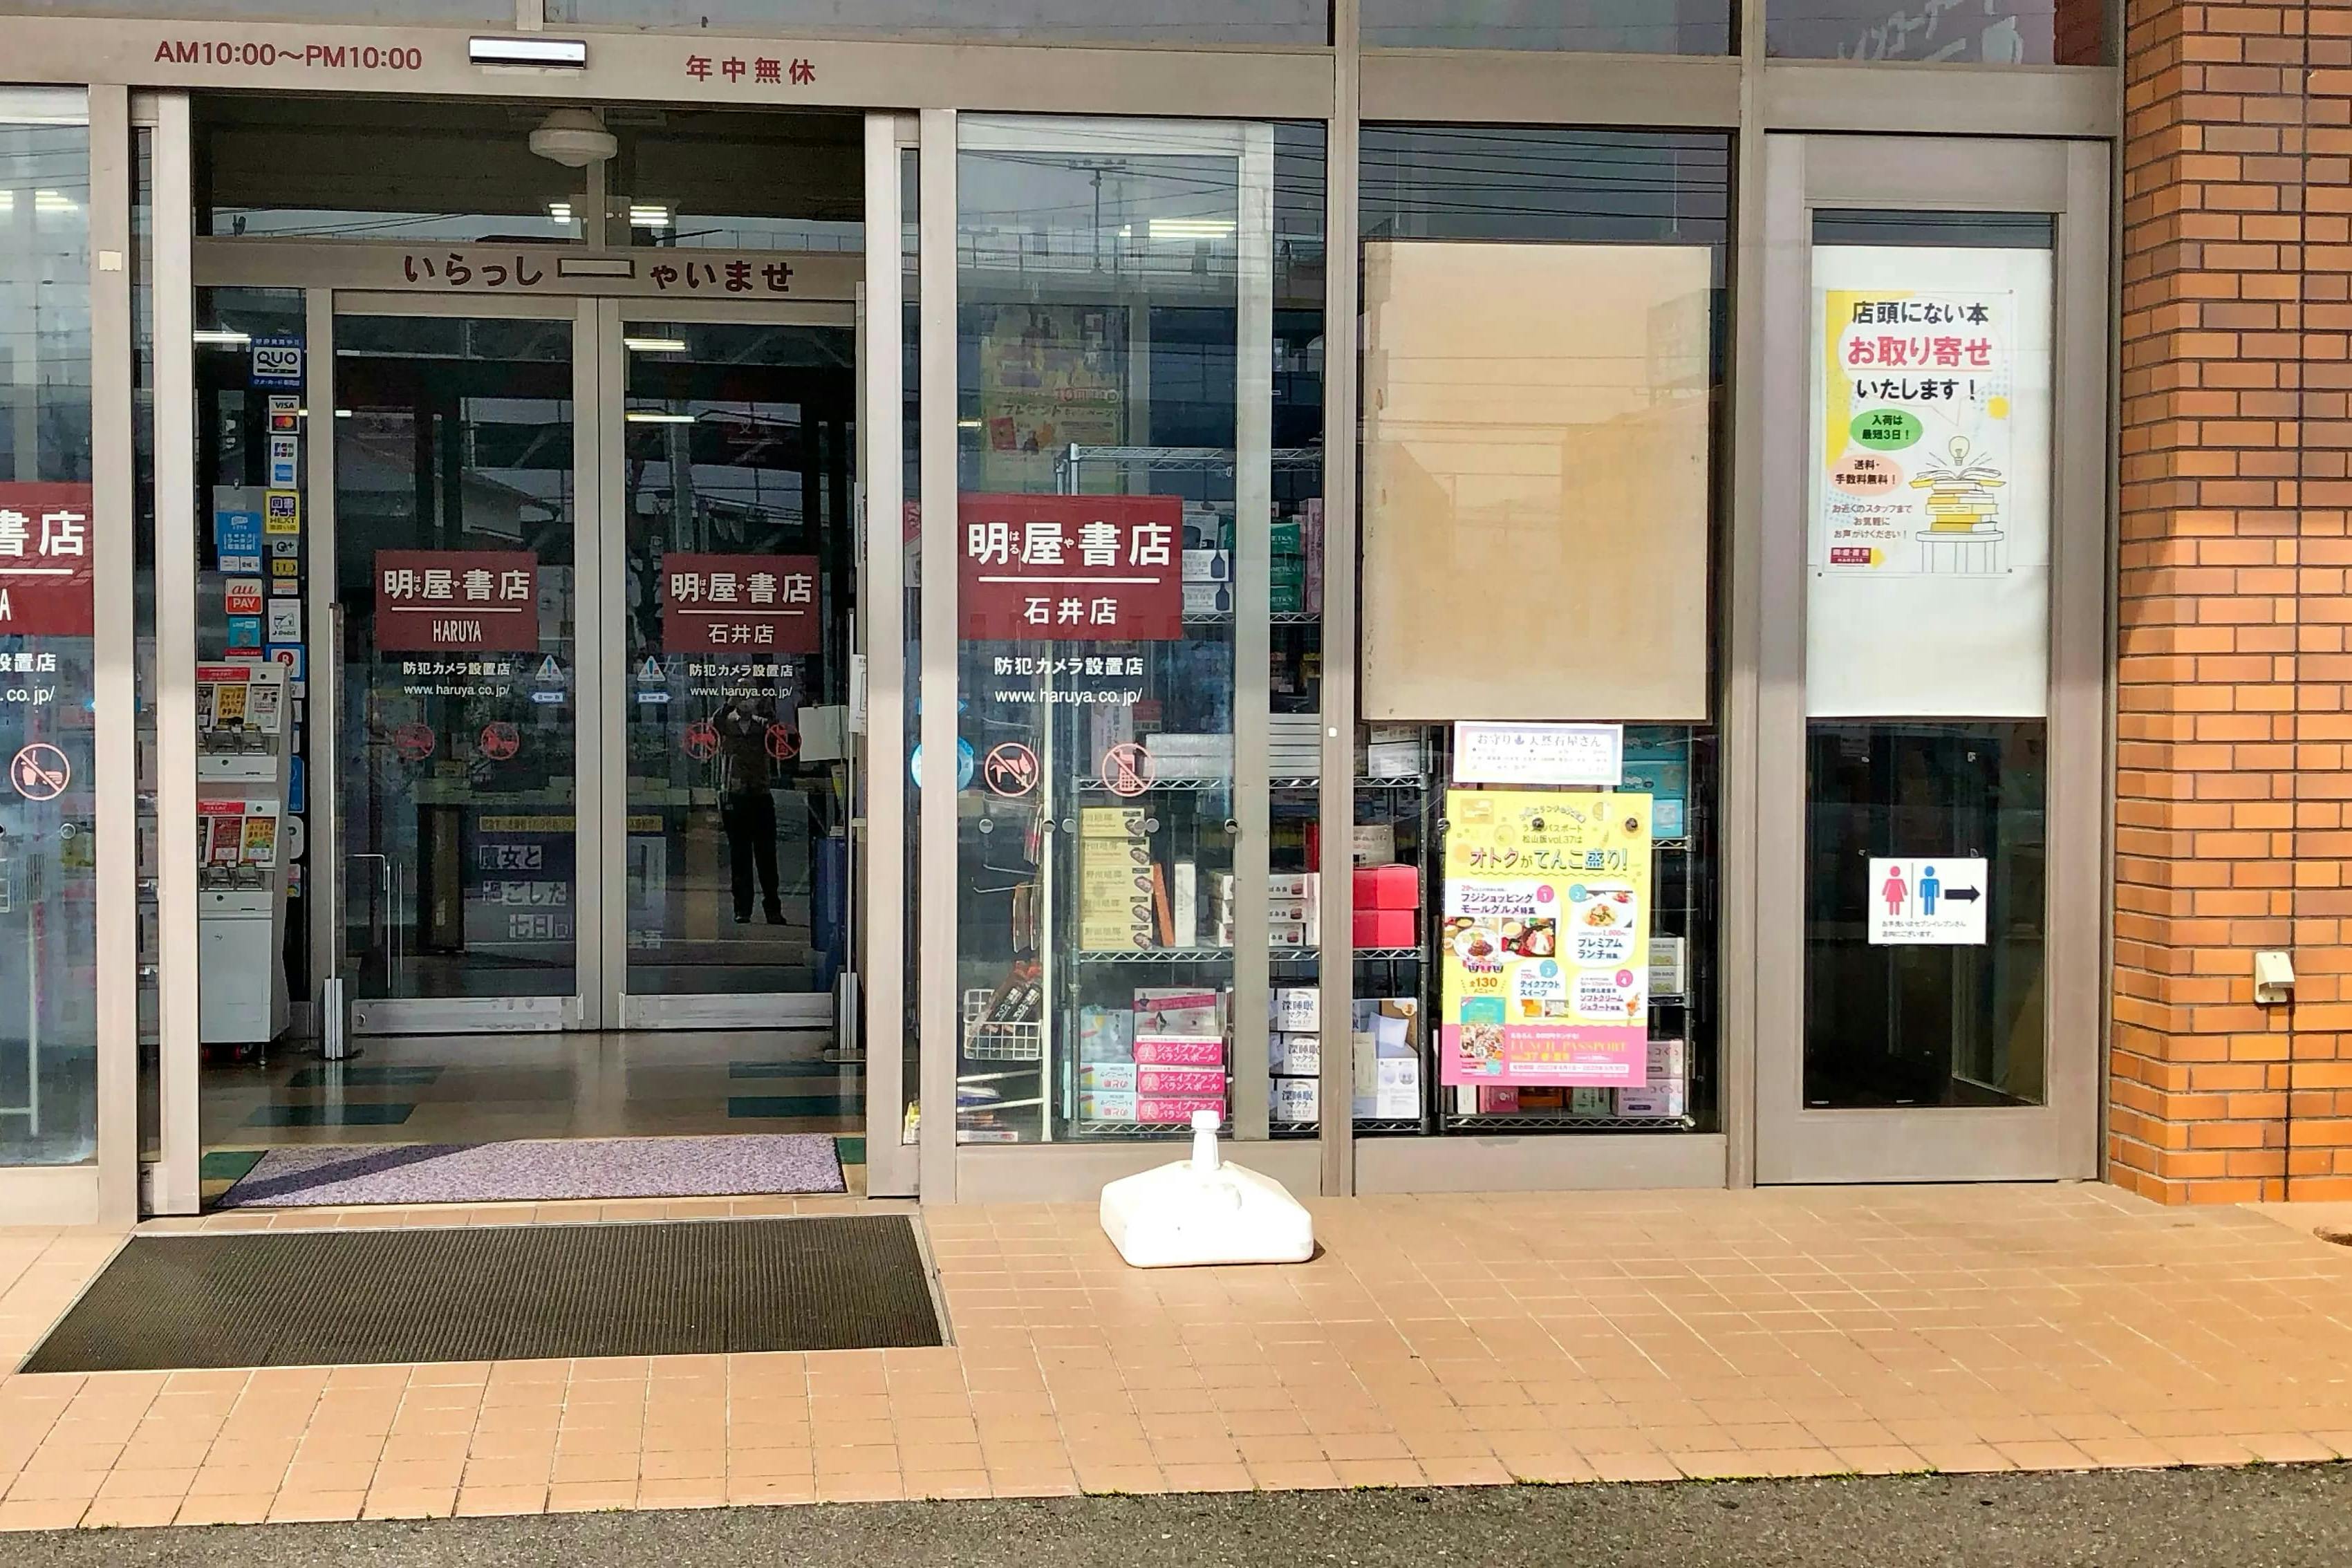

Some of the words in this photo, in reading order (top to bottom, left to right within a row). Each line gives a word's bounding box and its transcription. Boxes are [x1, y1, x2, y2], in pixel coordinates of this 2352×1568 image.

[686, 55, 816, 86] 年中無休
[404, 253, 543, 286] いらっし
[651, 261, 793, 292] やいませ
[1851, 301, 1989, 326] 店頭にない本
[256, 351, 297, 367] QUO
[1847, 337, 1992, 366] お取り寄せ
[1856, 378, 1975, 400] いたします！
[1872, 415, 1903, 426] 入荷は
[232, 597, 256, 608] PAY
[1024, 597, 1118, 625] 石井店
[433, 620, 481, 642] HARUYA
[708, 624, 774, 644] 石井店
[403, 662, 510, 676] 防犯カメラ設置店
[689, 664, 793, 678] 防犯カメラ設置店
[994, 657, 1144, 676] 防犯カメラ設置店
[404, 684, 510, 697] www.haruya.co.jp/
[690, 686, 792, 699] www.haruya.co.jp/
[994, 687, 1142, 707] www.haruya.co.jp/
[1462, 893, 1533, 903] フジショッピング
[1578, 939, 1623, 948] プレミアム
[1159, 1110, 1192, 1119] バランス
